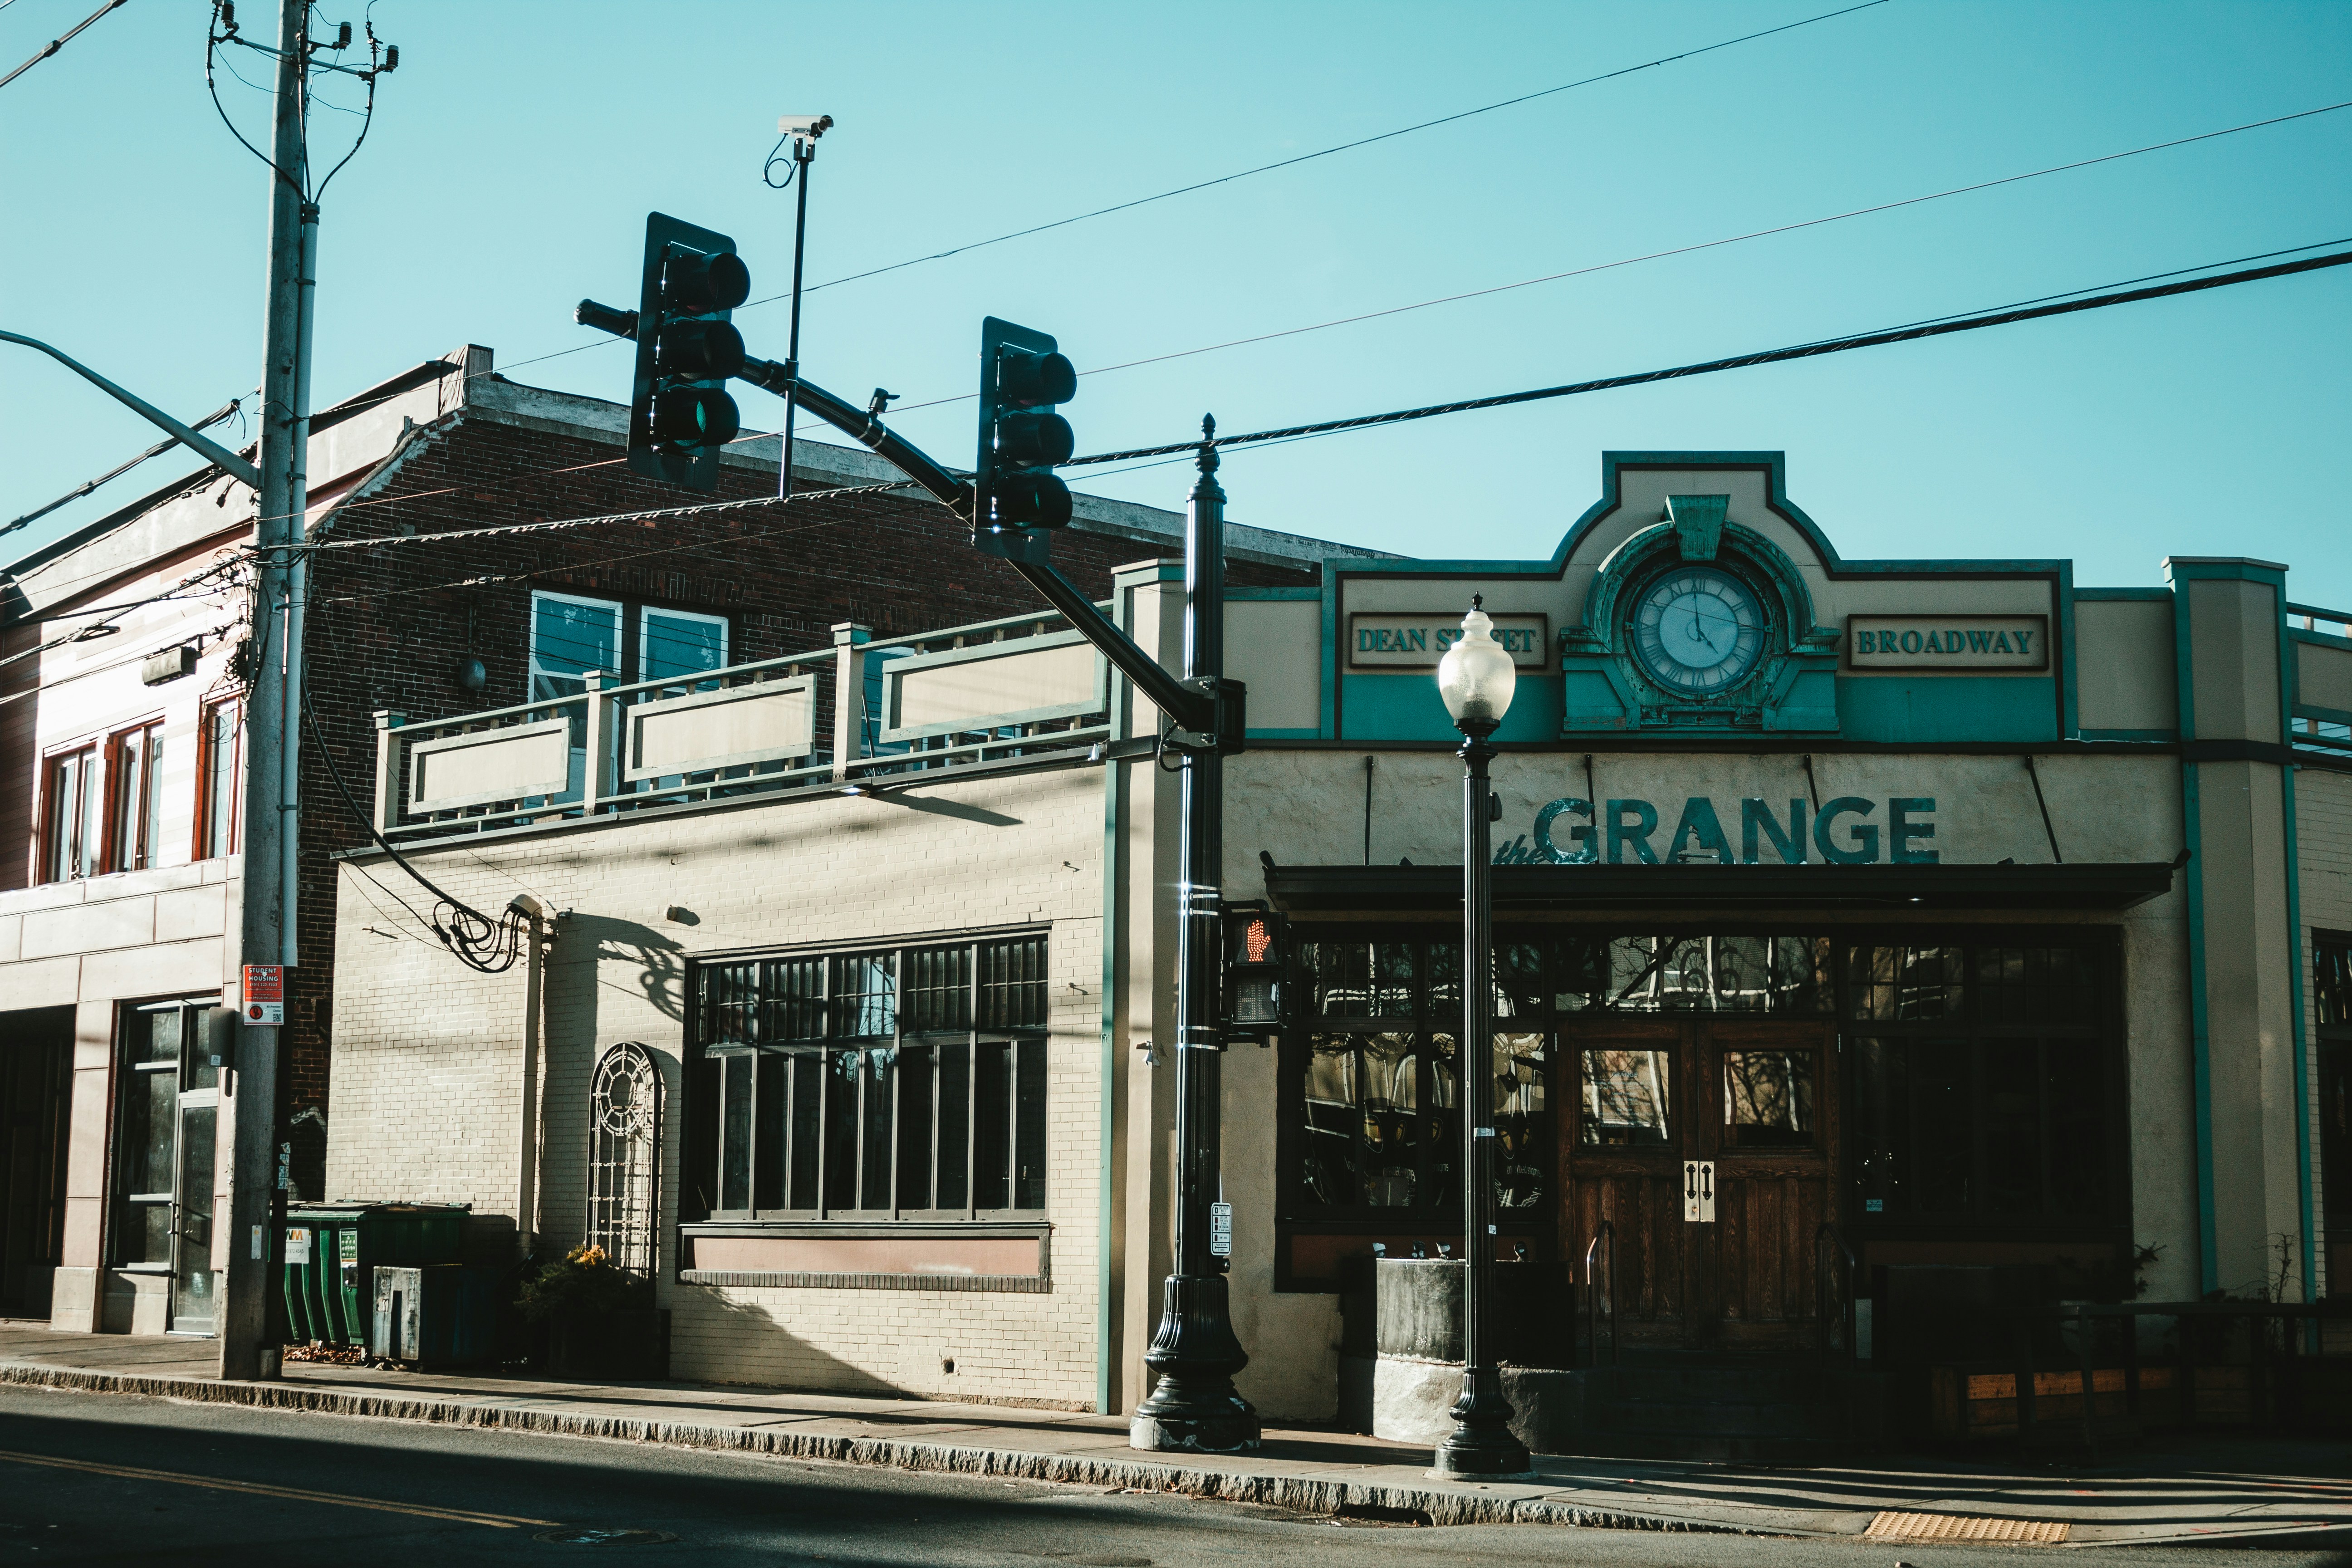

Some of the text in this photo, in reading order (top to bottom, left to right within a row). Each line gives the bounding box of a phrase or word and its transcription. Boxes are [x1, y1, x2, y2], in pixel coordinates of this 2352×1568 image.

[1358, 628, 1427, 652] DEAN
[1857, 630, 2034, 653] BROADWAY
[1492, 797, 1939, 865] the GRANGE
[1648, 946, 1741, 1004] 166
